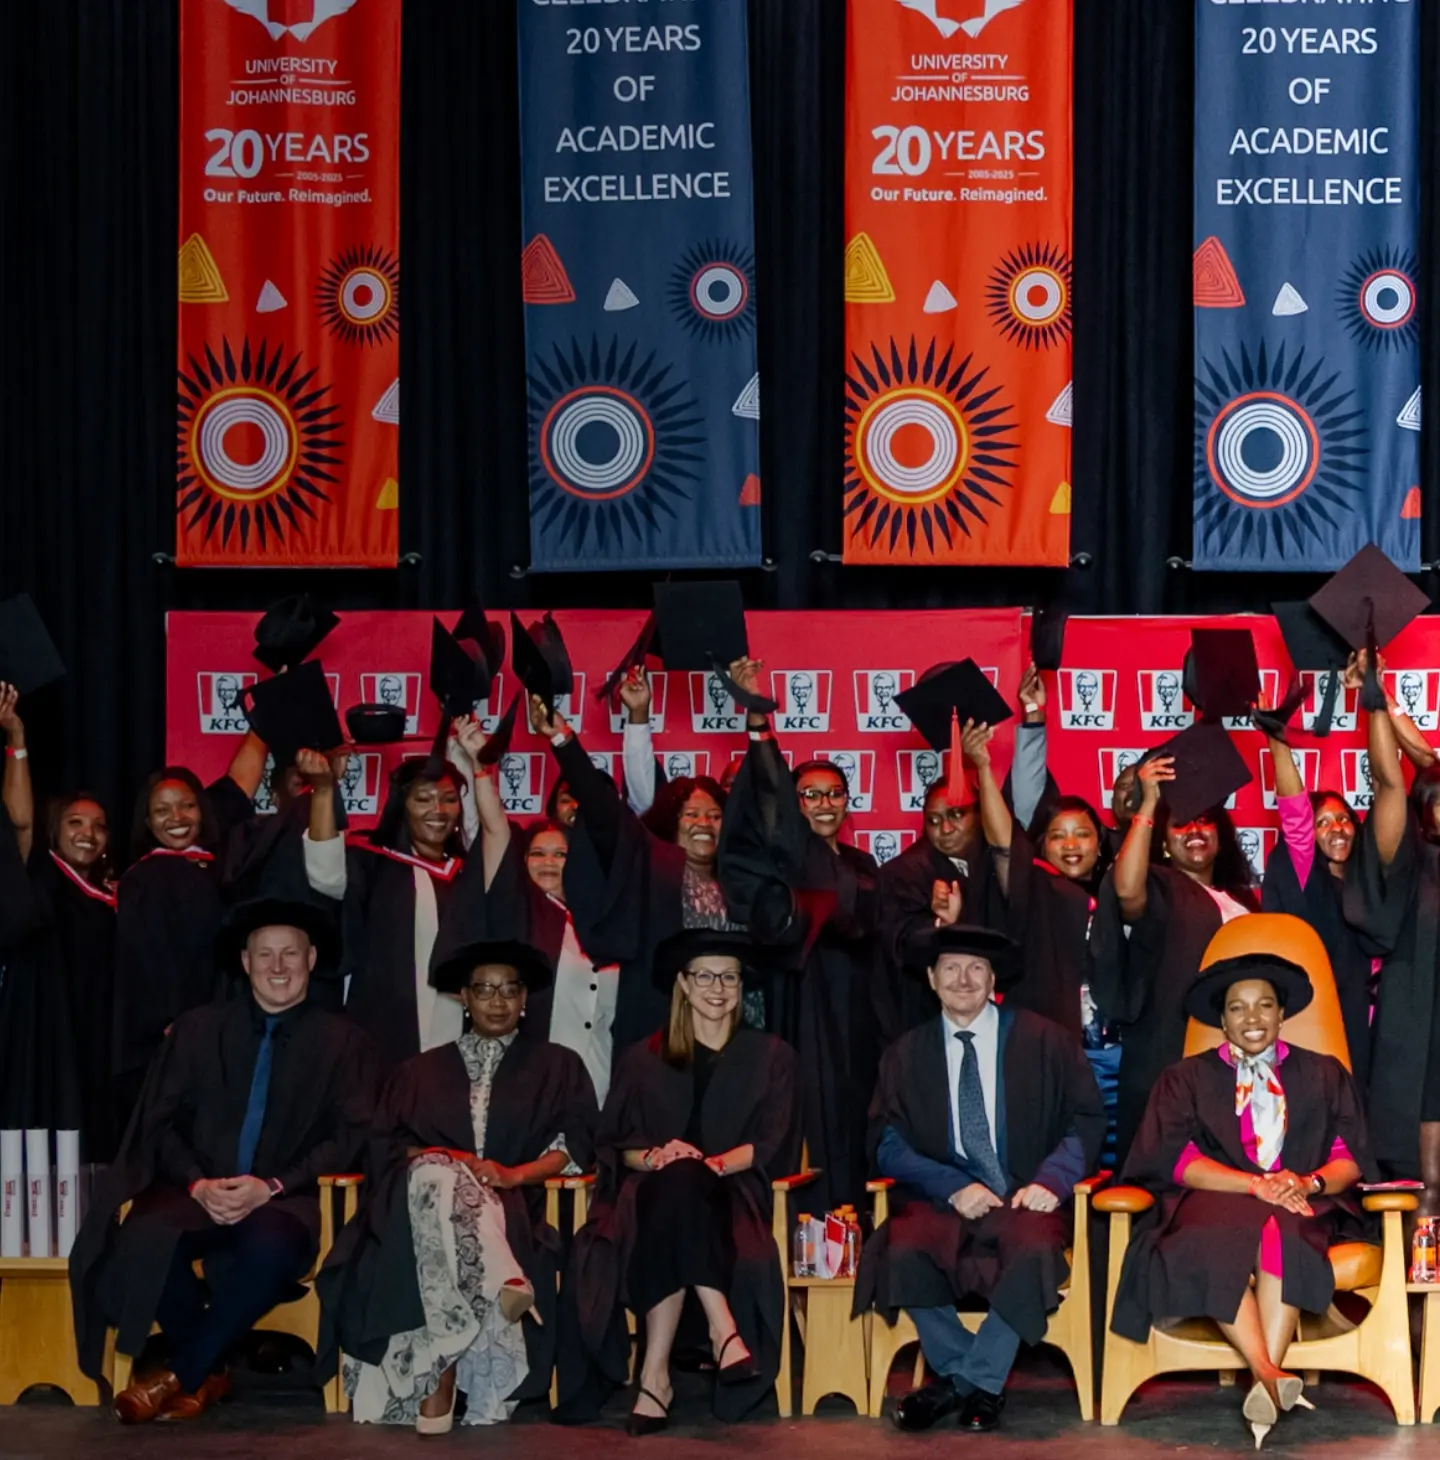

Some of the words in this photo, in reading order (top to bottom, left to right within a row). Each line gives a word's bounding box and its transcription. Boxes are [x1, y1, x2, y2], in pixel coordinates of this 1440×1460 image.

[566, 27, 600, 54] 20
[604, 25, 701, 52] YEARS
[1242, 27, 1276, 54] 20
[1280, 27, 1378, 54] YEARS
[245, 57, 338, 74] UNIVERSITY
[911, 54, 1008, 70] UNIVERSITY
[280, 74, 296, 85] OF
[952, 72, 968, 83] OF
[225, 88, 356, 105] JOHANNESBURG
[613, 75, 656, 102] OF
[891, 86, 1029, 102] JOHANNESBURG
[1288, 77, 1331, 104] OF
[555, 122, 715, 153] ACADEMIC
[1229, 127, 1389, 155] ACADEMIC
[205, 128, 264, 178] 20
[265, 132, 370, 164] YEARS
[871, 125, 932, 176] 20
[933, 130, 1046, 160] YEARS
[544, 172, 731, 203] EXCELLENCE
[870, 187, 899, 201] Our
[904, 187, 957, 201] Future.
[960, 187, 1048, 204] Reimagined.
[1216, 177, 1403, 205] EXCELLENCE
[204, 188, 233, 202] Our
[237, 190, 285, 203] Future.
[289, 188, 372, 207] Reimagined.
[210, 718, 246, 731] KFC
[702, 717, 738, 729] KFC
[784, 716, 820, 728] KFC
[866, 716, 903, 728] KFC
[1070, 714, 1105, 727] KFC
[1150, 714, 1186, 727] KFC
[347, 799, 369, 811] FC
